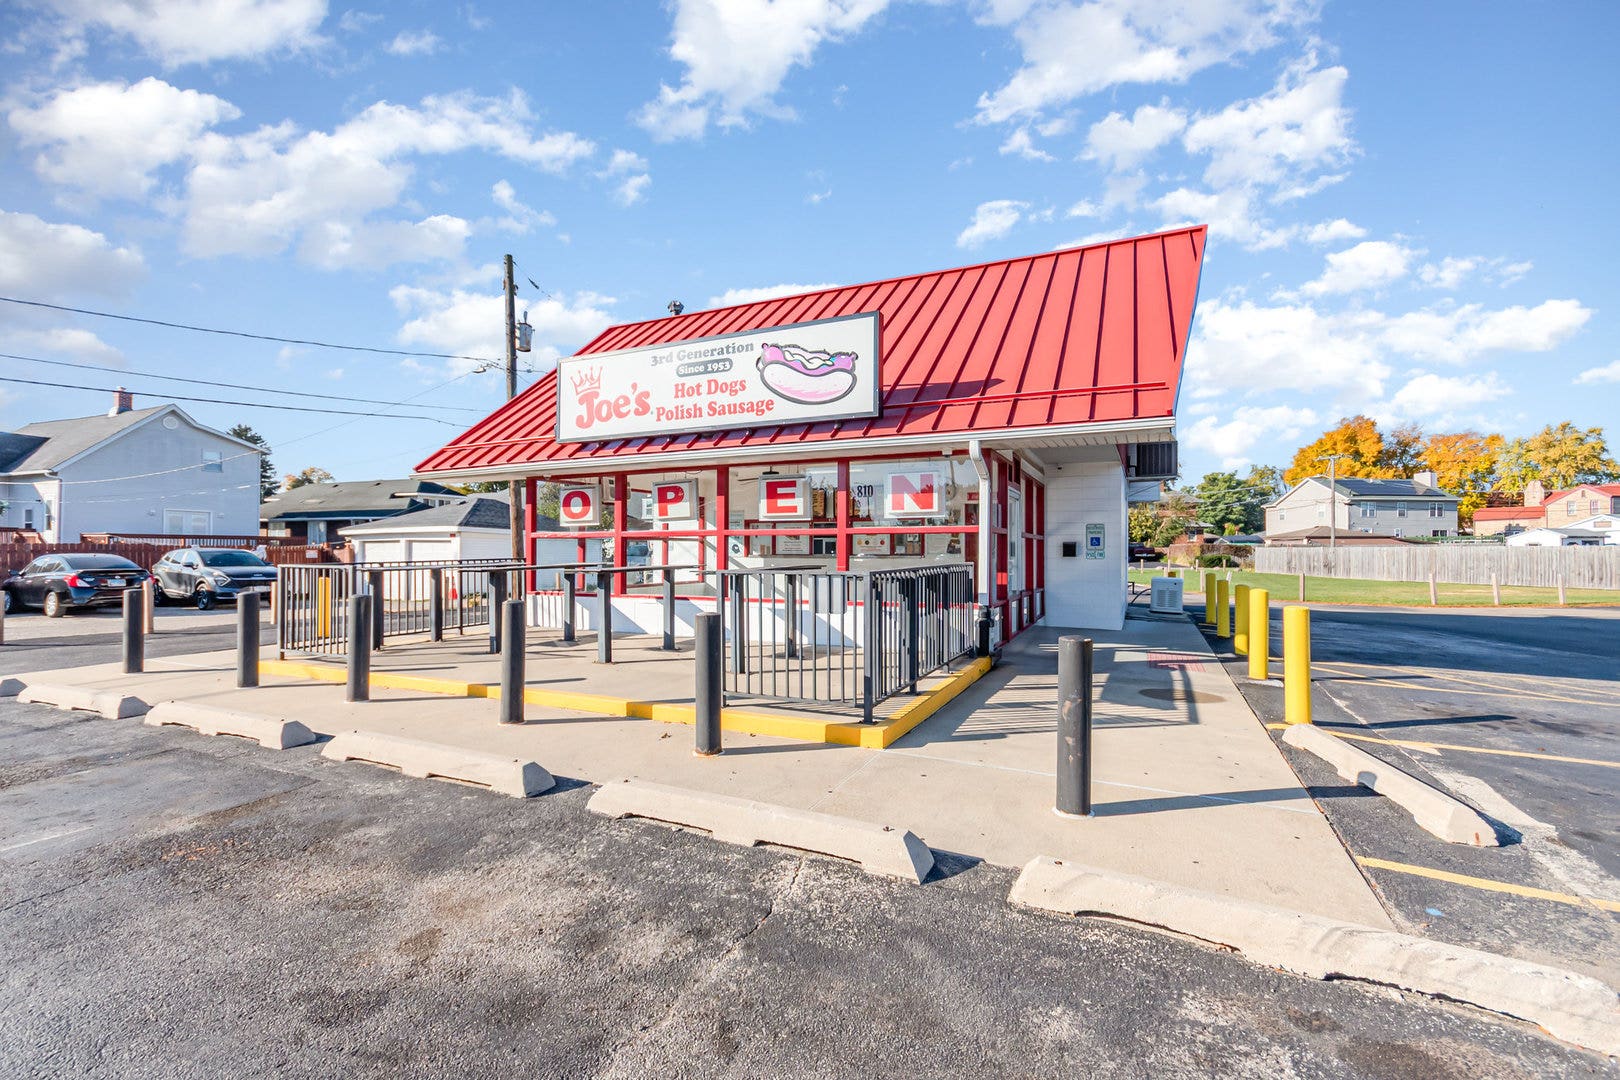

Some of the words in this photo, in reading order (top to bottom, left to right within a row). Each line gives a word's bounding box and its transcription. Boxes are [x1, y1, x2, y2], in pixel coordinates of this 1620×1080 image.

[650, 350, 673, 367] 3rd
[676, 340, 754, 362] Generation
[678, 362, 705, 375] Since
[706, 360, 730, 372] 1953
[673, 380, 702, 399] Hot
[706, 377, 747, 396] Dogs
[575, 382, 651, 429] Joe's
[656, 402, 703, 422] Polish
[707, 397, 774, 419] Sausage
[857, 484, 874, 498] 810
